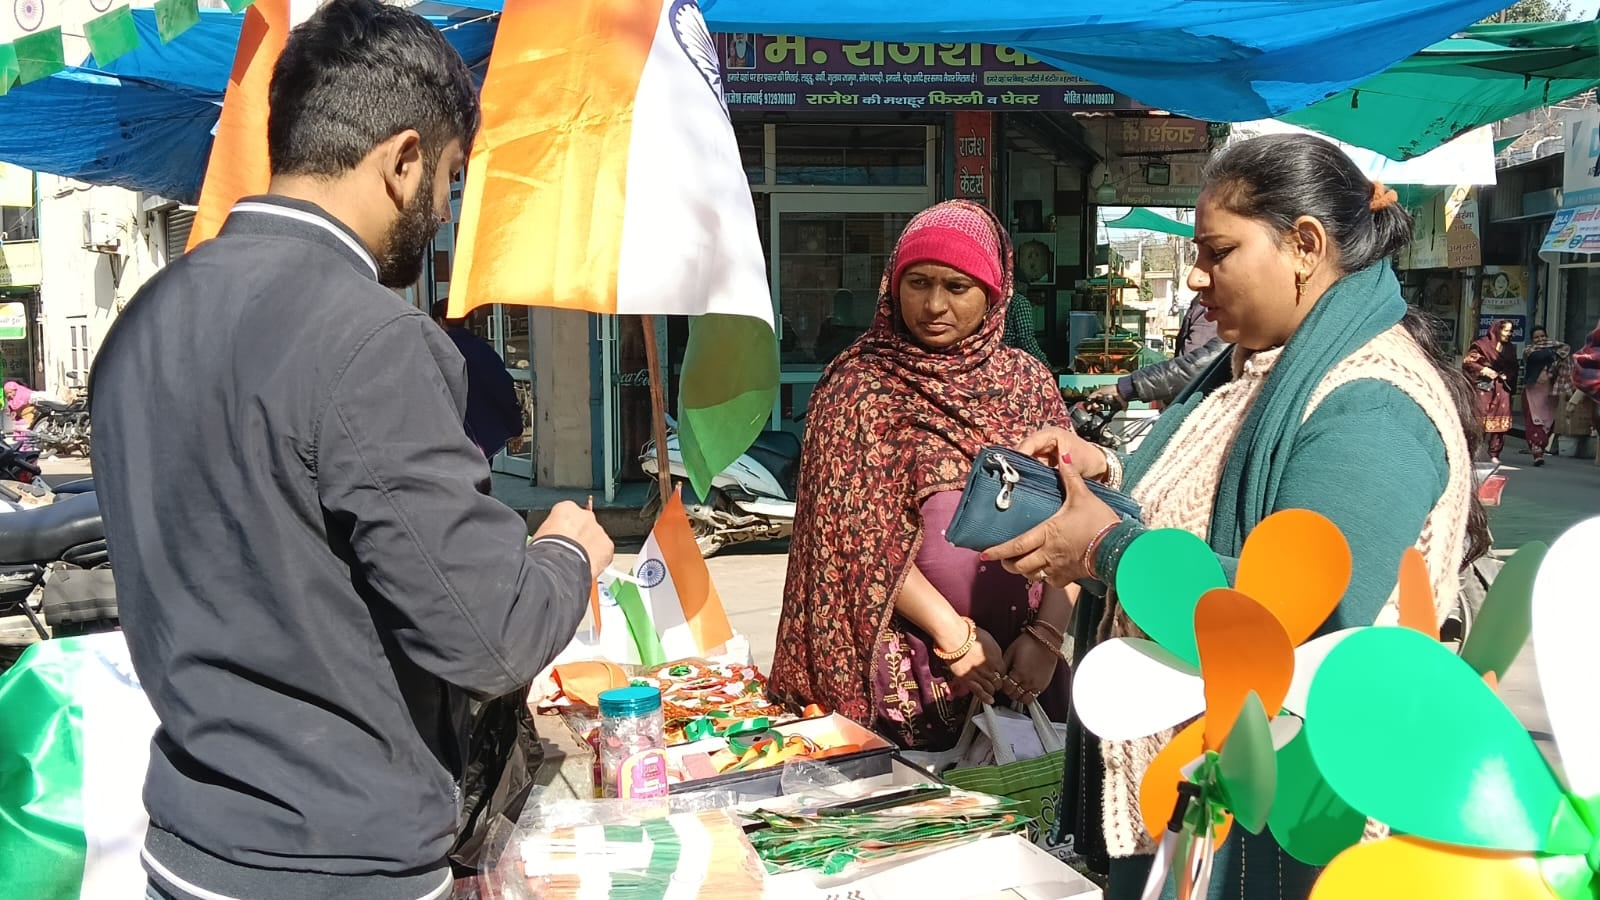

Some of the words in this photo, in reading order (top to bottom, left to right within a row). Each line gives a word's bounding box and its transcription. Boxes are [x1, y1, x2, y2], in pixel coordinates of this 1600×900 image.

[742, 90, 763, 105] हलवाई
[805, 90, 859, 105] राजेश
[862, 94, 881, 105] की
[883, 96, 926, 108] मशहूर
[928, 90, 984, 105] फिरनी
[987, 96, 998, 105] व
[1001, 90, 1040, 105] घेवर
[959, 129, 985, 156] राजेश
[960, 166, 984, 194] कैटर्स
